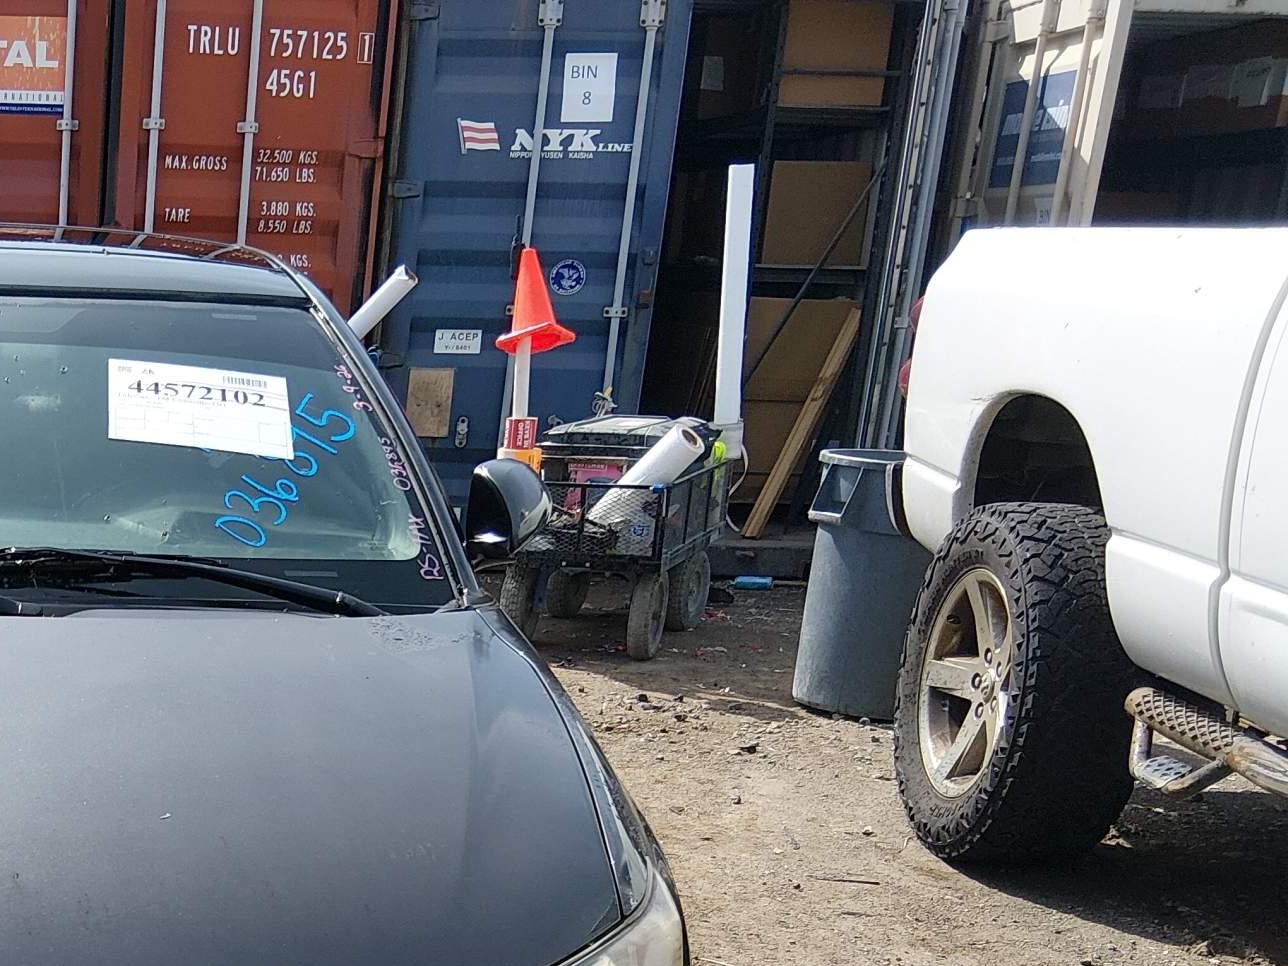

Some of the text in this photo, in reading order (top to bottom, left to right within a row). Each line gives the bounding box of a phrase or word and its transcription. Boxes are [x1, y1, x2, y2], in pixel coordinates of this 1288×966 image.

[187, 24, 240, 56] TRLU
[269, 28, 347, 60] 757125
[570, 65, 598, 79] BIN
[265, 69, 316, 98] 45G1
[582, 91, 592, 105] 8
[511, 128, 633, 152] NYK LINE
[298, 151, 318, 164] KGS.
[541, 151, 563, 159] YUSEN
[568, 151, 593, 159] KAISHA
[296, 168, 316, 183] LBS.
[164, 208, 191, 223] TARE
[295, 201, 316, 217] KGS.
[292, 220, 313, 234] LBS.
[450, 332, 479, 341] ACEP
[127, 380, 266, 407] 44572102
